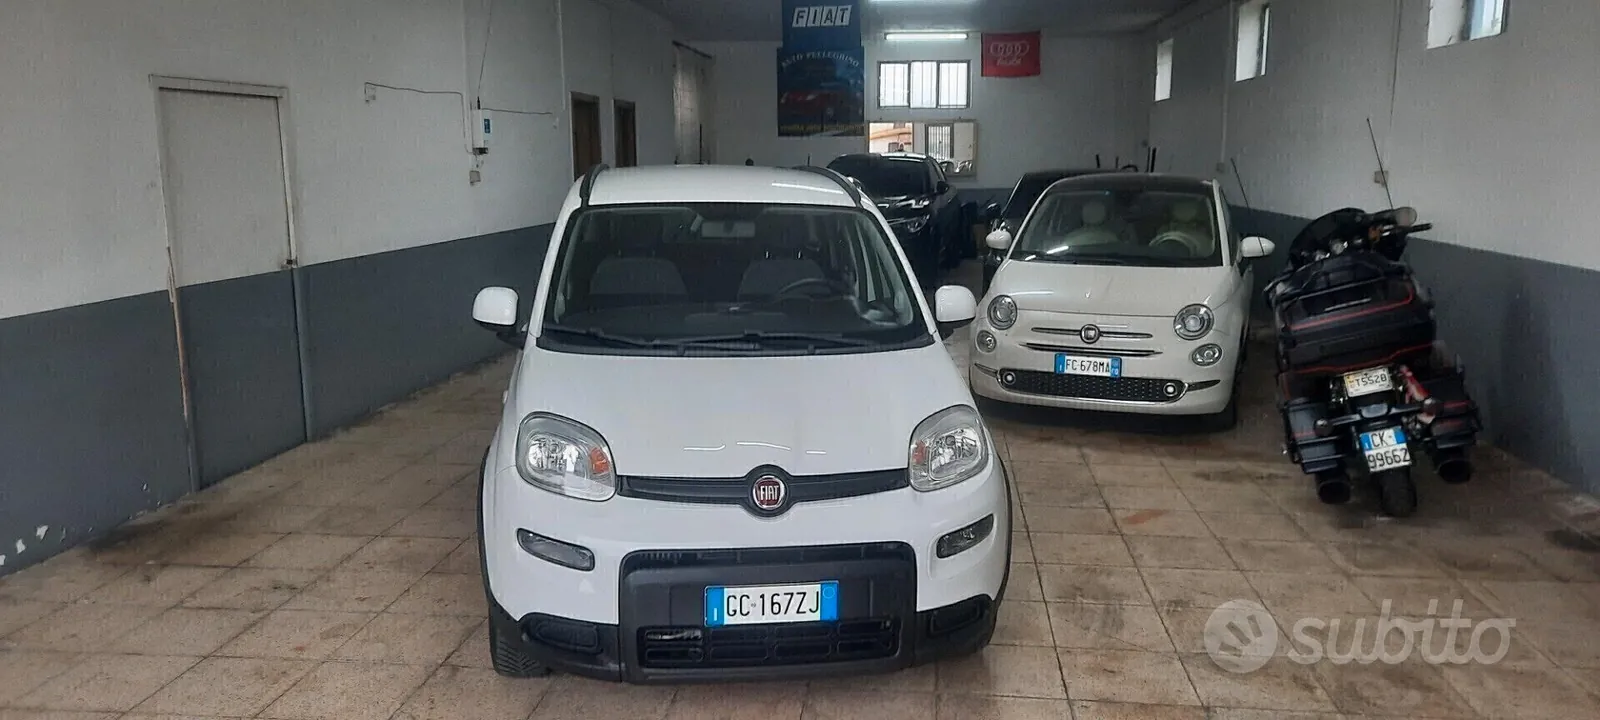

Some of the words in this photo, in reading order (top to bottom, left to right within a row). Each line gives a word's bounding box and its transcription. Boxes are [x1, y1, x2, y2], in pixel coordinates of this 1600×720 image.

[792, 5, 852, 27] FIAT
[1065, 359, 1078, 371] FC
[1080, 360, 1110, 374] 678MA
[1370, 432, 1389, 447] CK
[1367, 448, 1409, 469] 99662
[760, 485, 779, 500] FIAT
[726, 594, 750, 616] GC
[760, 590, 820, 616] 167ZJ
